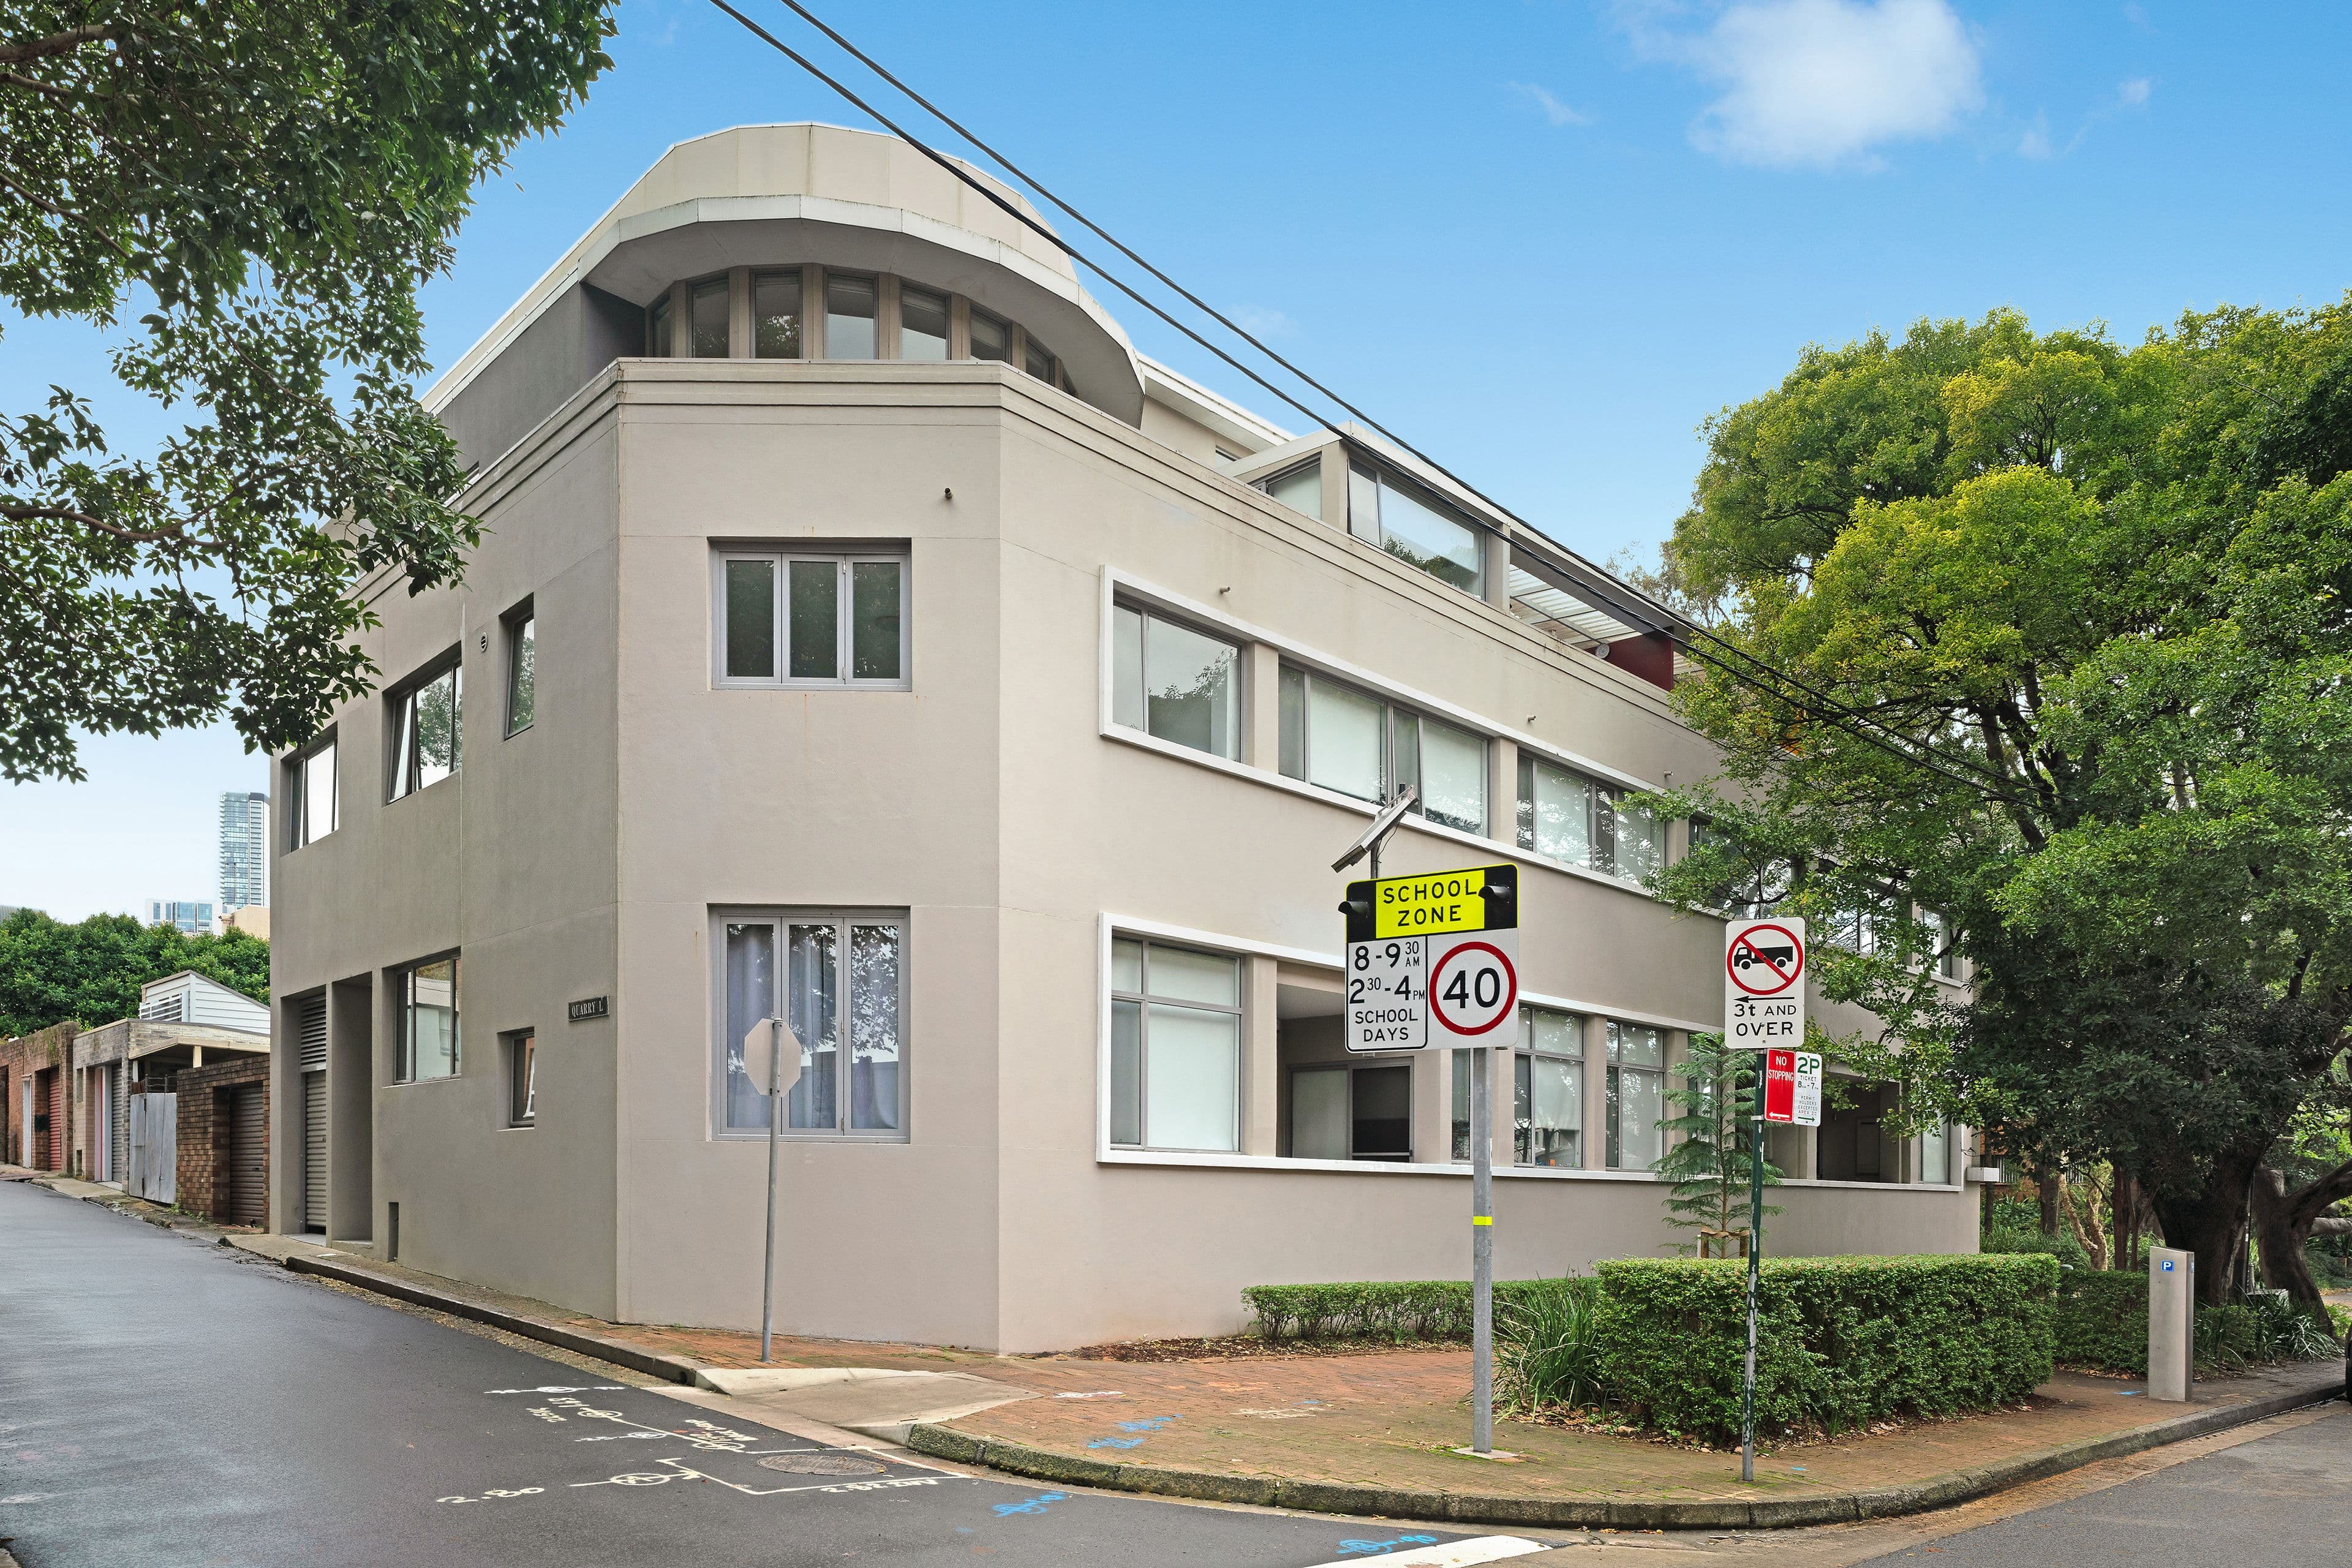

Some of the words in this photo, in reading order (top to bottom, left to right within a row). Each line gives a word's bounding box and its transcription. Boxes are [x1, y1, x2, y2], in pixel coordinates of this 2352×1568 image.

[1383, 879, 1477, 904] SCHOOL
[1398, 905, 1461, 927] ZONE
[1405, 957, 1420, 967] AM
[1442, 968, 1500, 1009] 40
[571, 1001, 596, 1017] QUARRY
[1355, 1008, 1418, 1025] SCHOOL
[1733, 1003, 1756, 1017] 3t
[1764, 1005, 1796, 1016] AND
[1363, 1027, 1409, 1042] DAYS
[1736, 1021, 1793, 1037] OVER
[1775, 1055, 1787, 1066] NO
[1797, 1057, 1820, 1074] 2P
[1768, 1068, 1794, 1082] STOPPING
